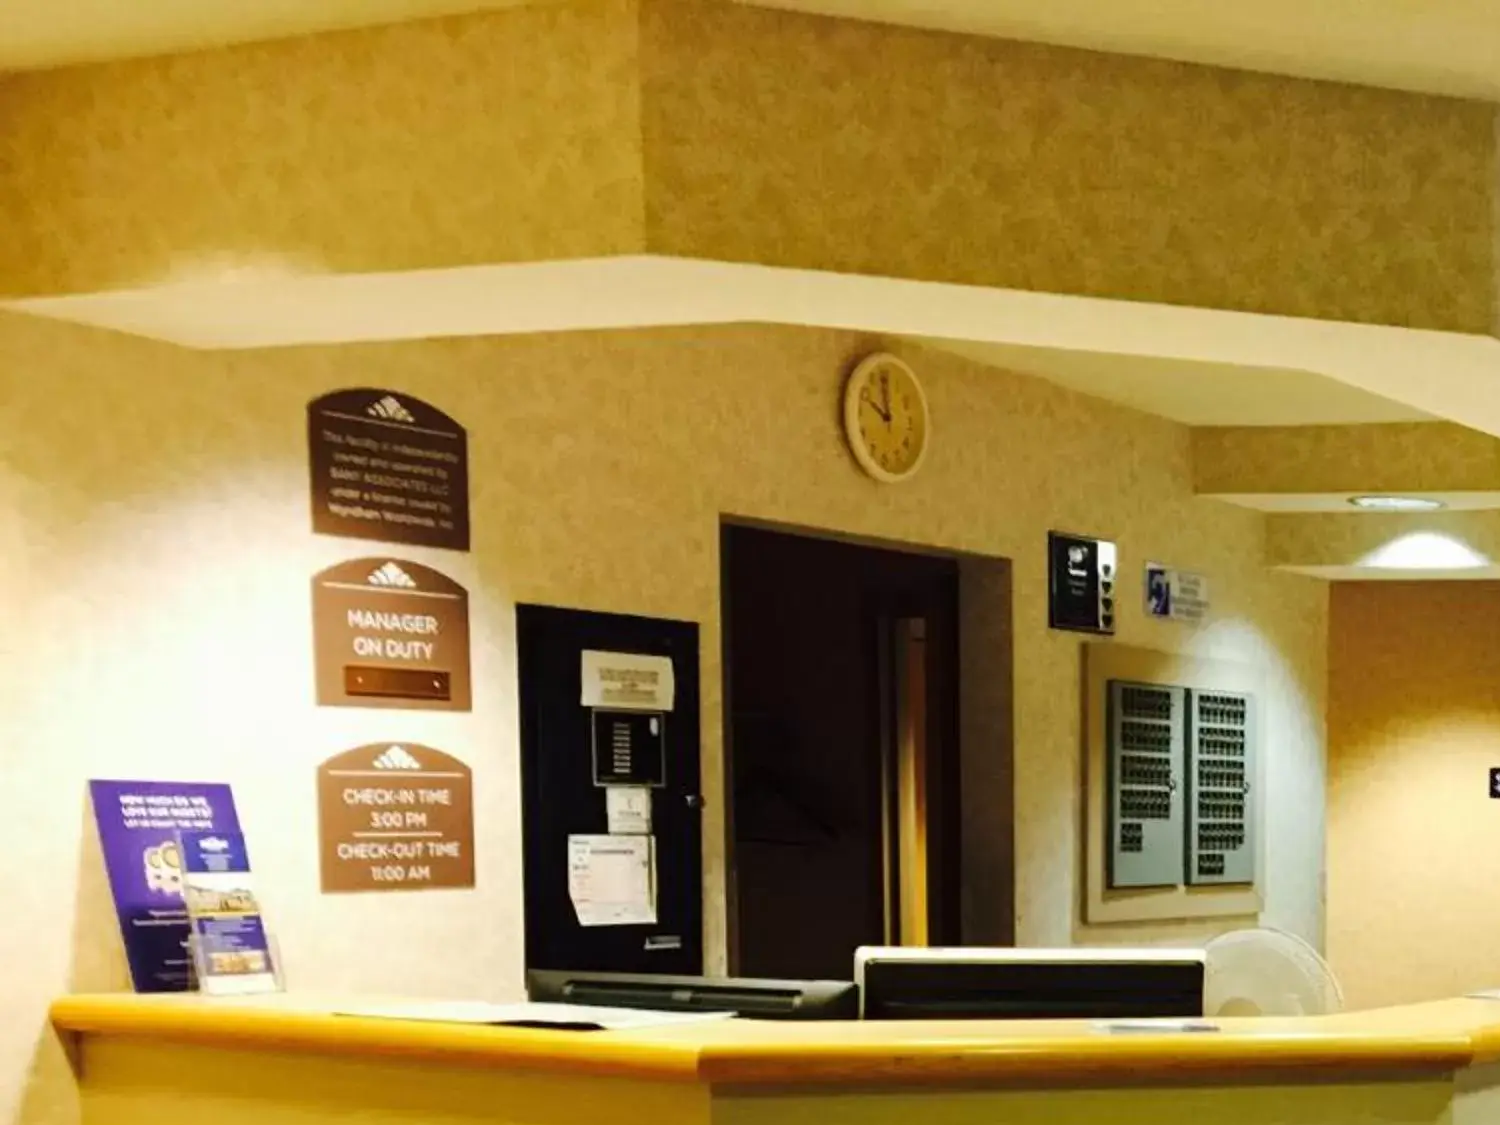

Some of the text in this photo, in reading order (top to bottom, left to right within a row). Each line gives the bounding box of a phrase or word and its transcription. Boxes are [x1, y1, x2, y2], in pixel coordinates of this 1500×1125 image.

[347, 608, 439, 635] MANAGER
[353, 636, 433, 660] ON DUTY
[343, 787, 451, 806] CHECK-IN TIME
[370, 811, 427, 829] 3:00 PM
[337, 841, 460, 860] CHECK-OUT TIME
[370, 865, 431, 881] 11:00 AM
